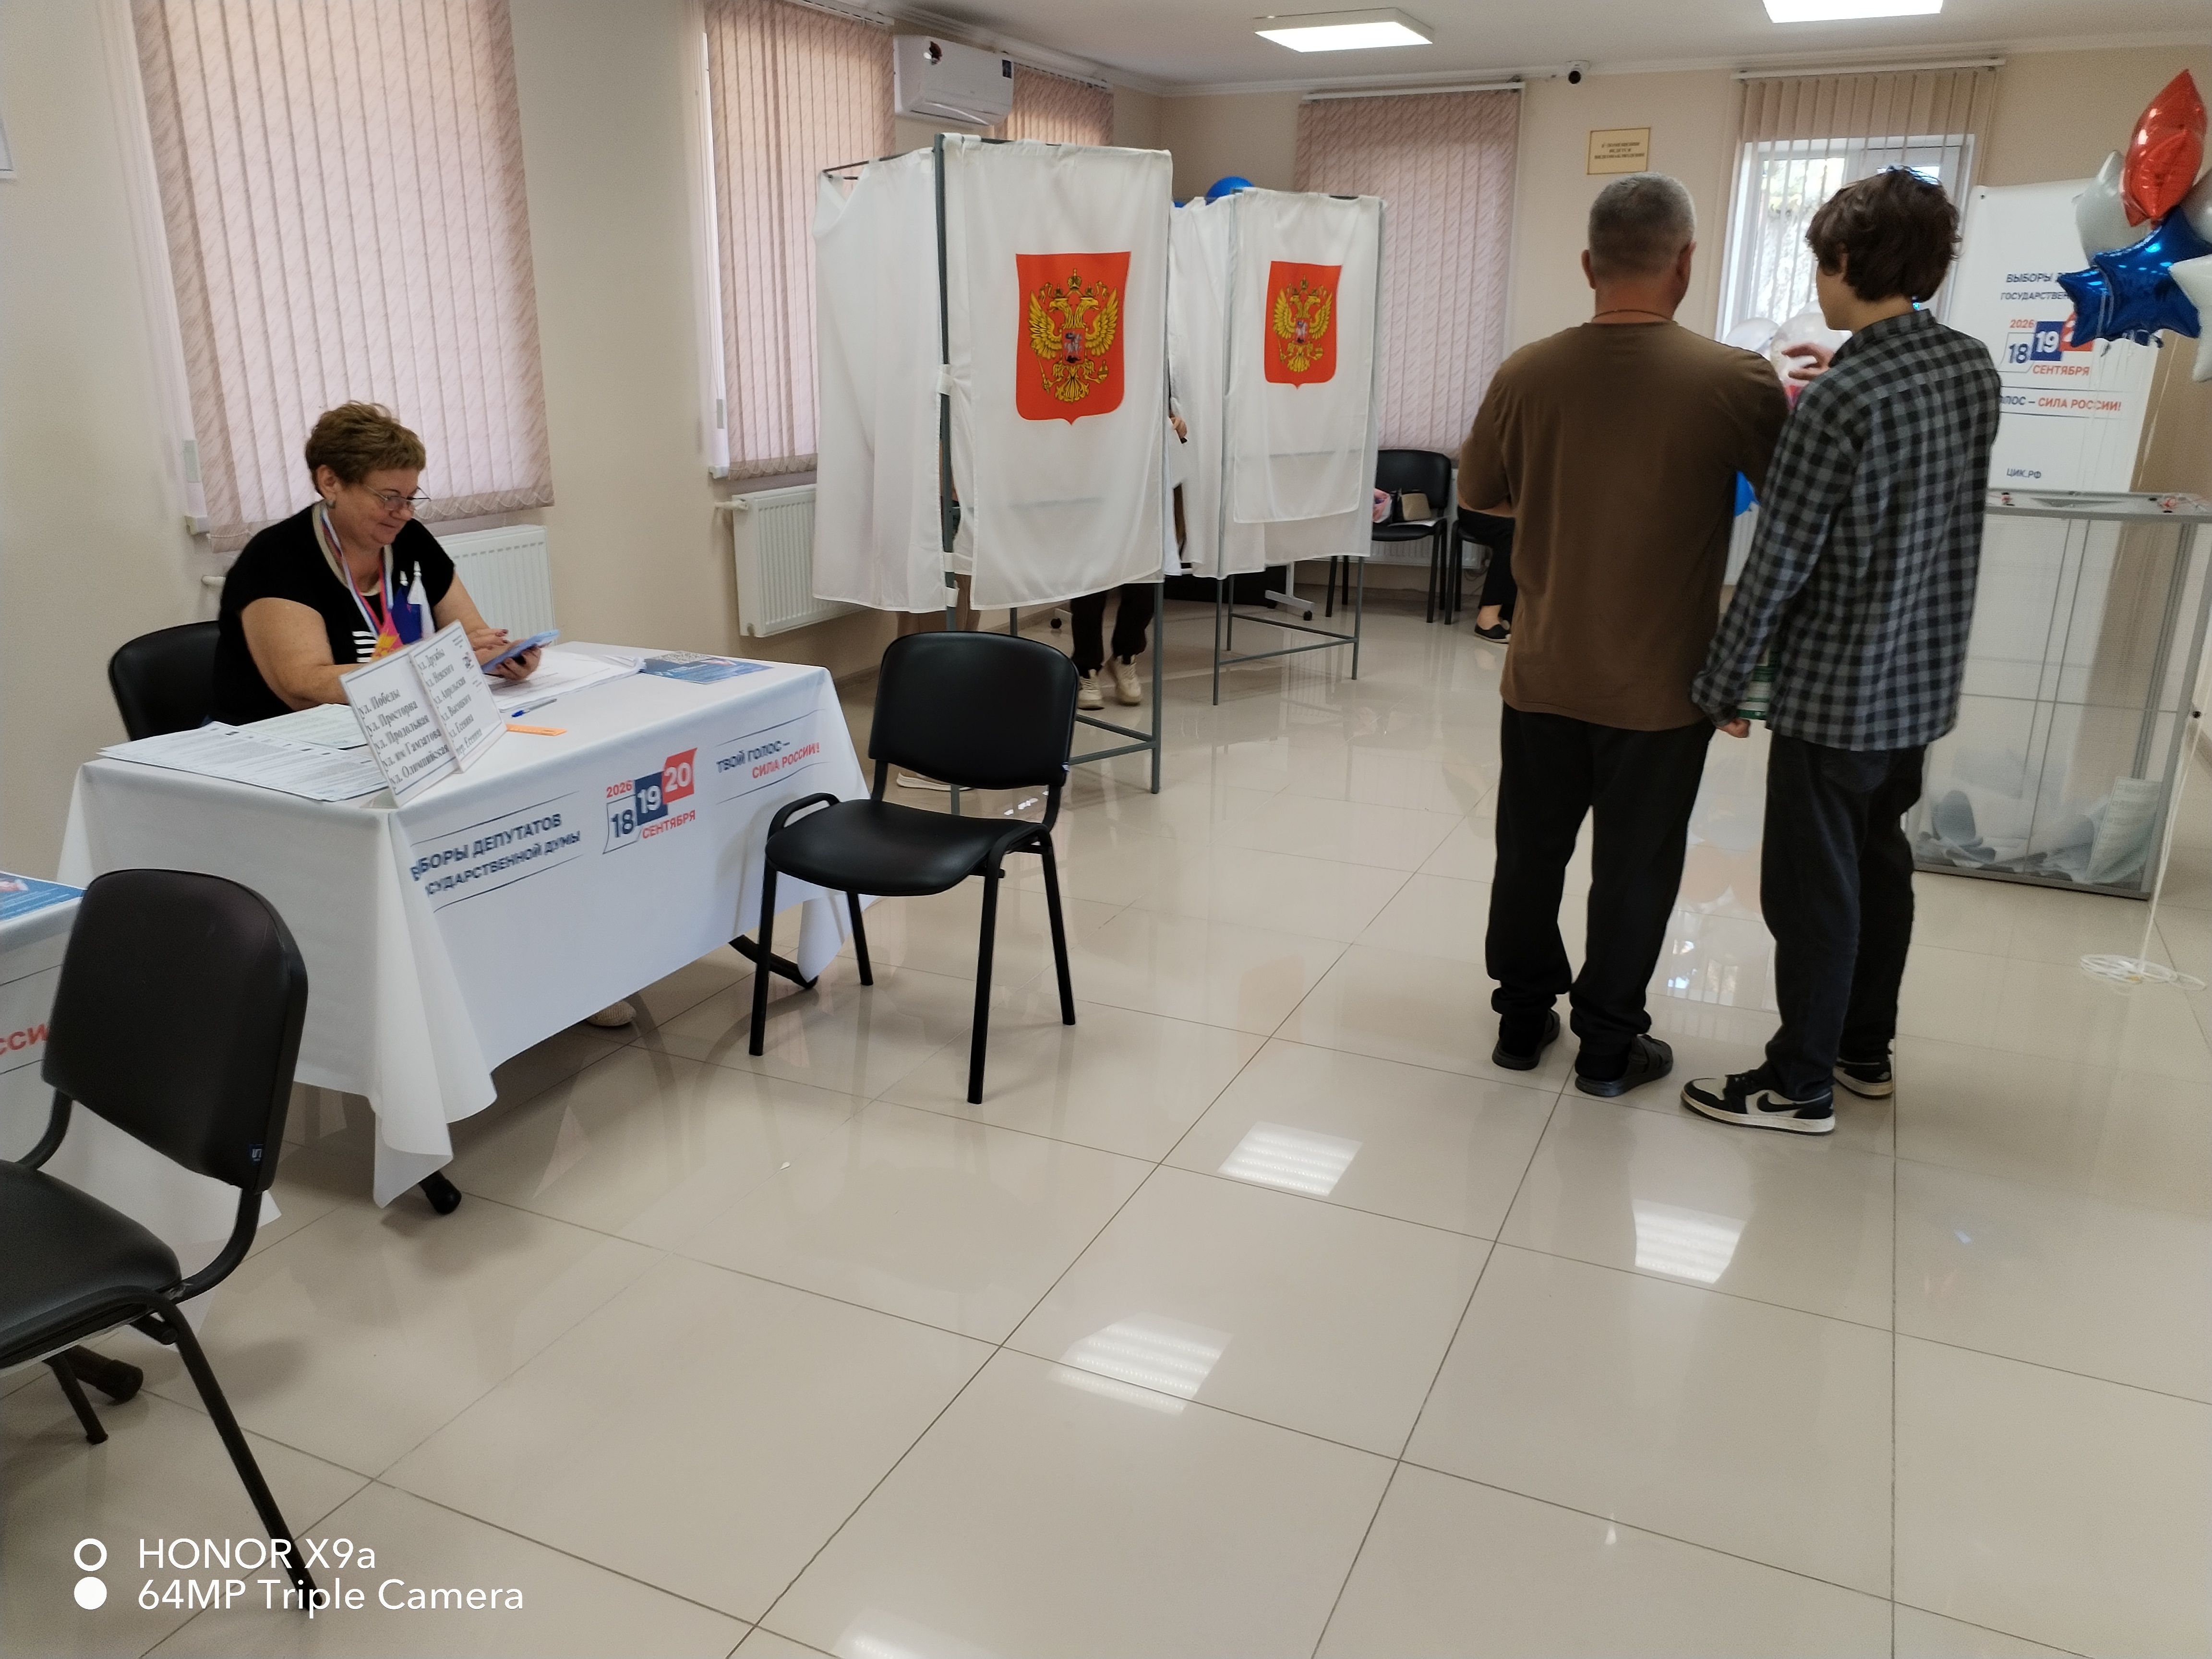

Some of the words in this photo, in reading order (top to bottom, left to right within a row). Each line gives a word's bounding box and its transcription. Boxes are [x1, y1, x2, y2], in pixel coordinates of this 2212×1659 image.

[2006, 272, 2054, 283] ВЫБОРЫ
[2000, 291, 2069, 301] ГОСУДАРСТВЕН
[2009, 319, 2035, 328] 2026
[2008, 343, 2029, 363] 18
[2036, 331, 2060, 353] 19
[2032, 365, 2090, 376] СЕНТЯБРЯ
[2038, 397, 2068, 409] СИЛА
[2070, 399, 2122, 411] РОССИИ!
[2007, 468, 2042, 479] ЦИК.РФ
[369, 689, 400, 710] Победы
[405, 729, 442, 755] Гамзатова
[716, 750, 745, 773] ТВОЙ
[752, 759, 780, 779] СИЛА
[782, 742, 820, 768] РОССИИ!
[606, 780, 633, 798] 2026
[611, 809, 634, 838] 18
[637, 785, 661, 814] 19
[664, 762, 692, 793] 20
[472, 813, 562, 858] ДЕПУТАТОВ
[642, 810, 696, 839] СЕНТЯБРЯ
[425, 843, 542, 898] СУДАРСТВЕННОЙ
[544, 830, 580, 855] ДУМЫ
